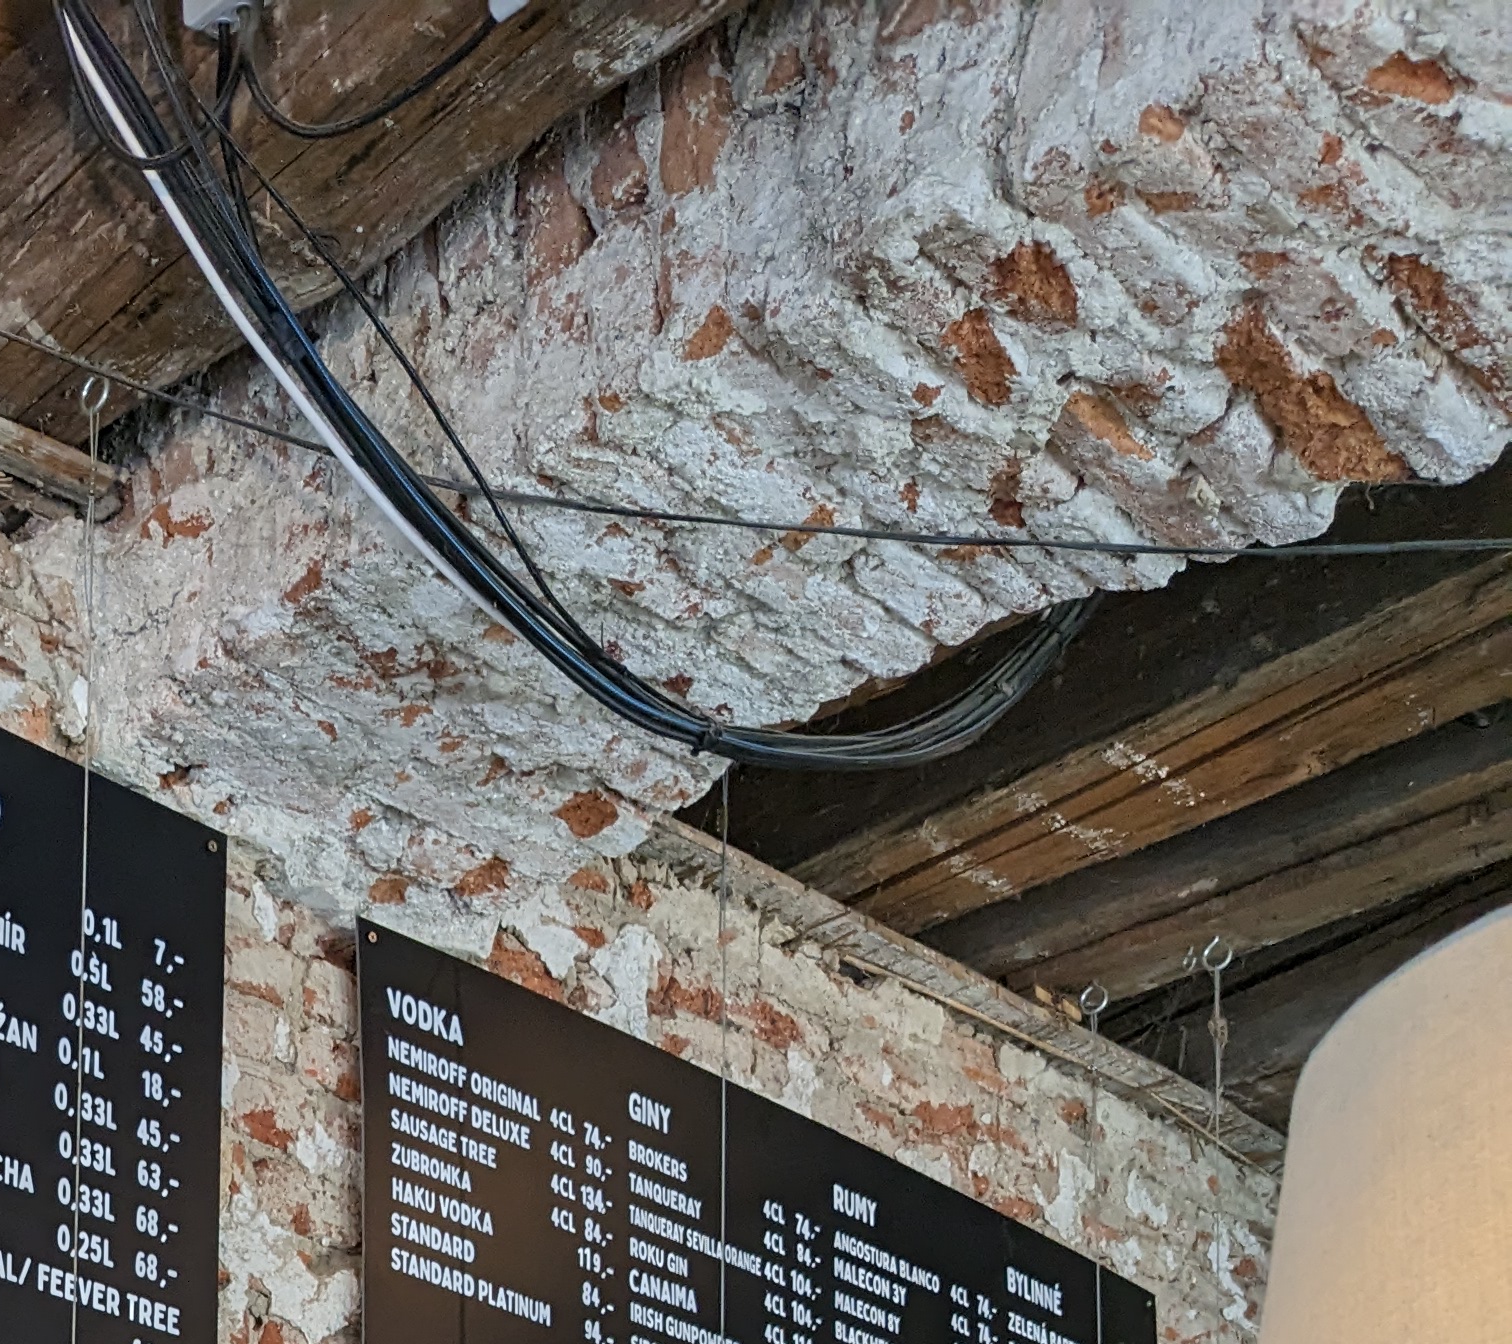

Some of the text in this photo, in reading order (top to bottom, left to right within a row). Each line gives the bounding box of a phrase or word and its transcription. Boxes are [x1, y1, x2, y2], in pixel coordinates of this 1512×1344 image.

[386, 987, 463, 1047] VODKA
[388, 1036, 467, 1088] NEMIROFF
[471, 1072, 541, 1123] ORIGINAL
[389, 1072, 530, 1150] NEMIROFF DELUXE
[628, 1092, 671, 1135] GINY
[391, 1108, 497, 1169] SAUSAGE TREE
[629, 1140, 687, 1183] BROKERS
[391, 1143, 472, 1194] ZUBROWKA
[392, 1178, 493, 1236] HAKU VODKA
[629, 1172, 702, 1221] TANQUERAY
[833, 1184, 877, 1227] RUMY
[391, 1212, 474, 1264] STANDARD
[629, 1237, 688, 1277] ROKU GIN
[834, 1231, 940, 1294] ANGOSTURA BLANCO
[38, 1264, 121, 1317] FEEVER
[127, 1294, 181, 1337] TREE
[391, 1247, 551, 1327] STANDARD PLATINUM
[629, 1269, 697, 1314] CANAIMA
[1007, 1266, 1062, 1317] BYLINNÉ
[630, 1302, 663, 1332] IRISH
